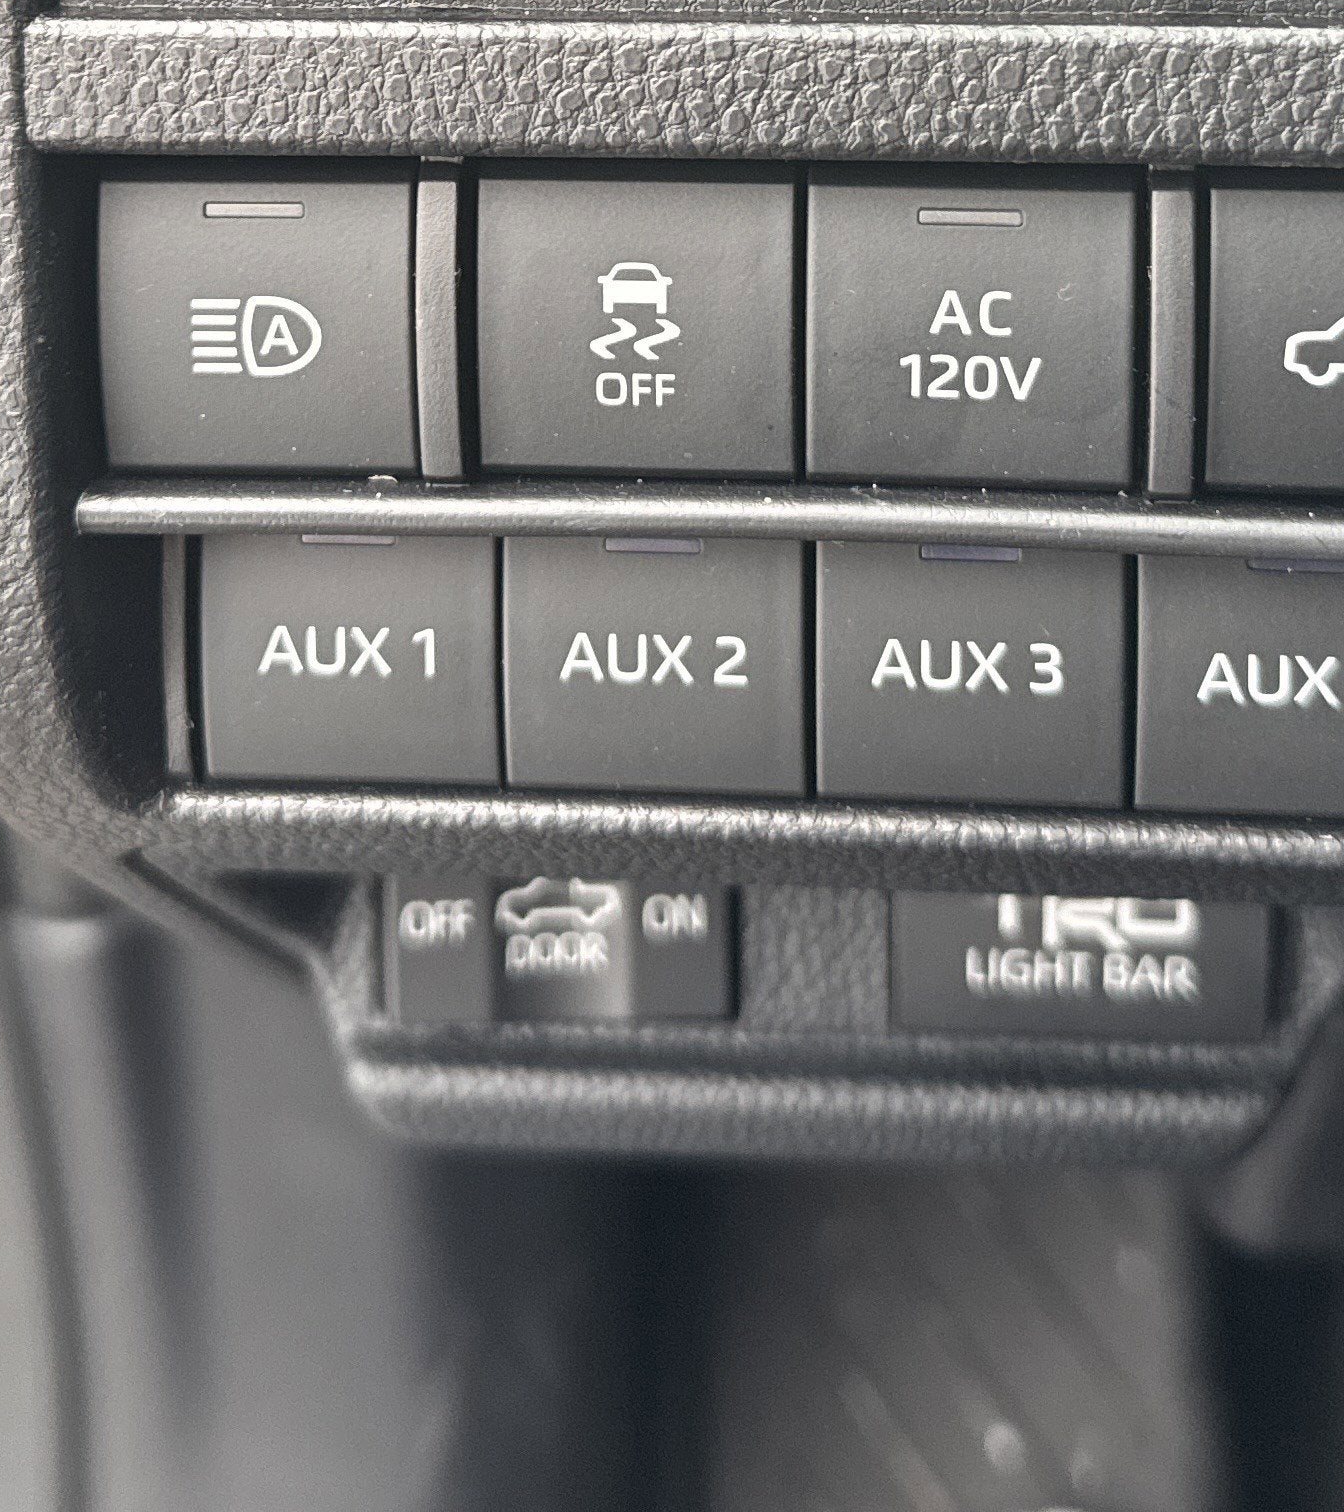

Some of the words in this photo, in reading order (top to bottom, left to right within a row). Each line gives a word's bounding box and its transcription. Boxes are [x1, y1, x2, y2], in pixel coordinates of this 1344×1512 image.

[260, 315, 298, 355] A
[929, 290, 1013, 336] AC
[594, 372, 675, 406] OFF
[899, 354, 1042, 401] 120V
[258, 625, 392, 677] AUX
[411, 628, 436, 678] 1
[559, 632, 694, 685] AUX
[712, 635, 749, 687] 2
[871, 638, 1010, 692] AUX
[1029, 643, 1065, 693] 3
[1197, 653, 1342, 709] AUX
[399, 898, 474, 944] OFF
[642, 893, 708, 938] ON
[505, 932, 609, 975] DOOR
[965, 946, 1093, 997] LIGHT
[1102, 954, 1198, 1003] BAR
